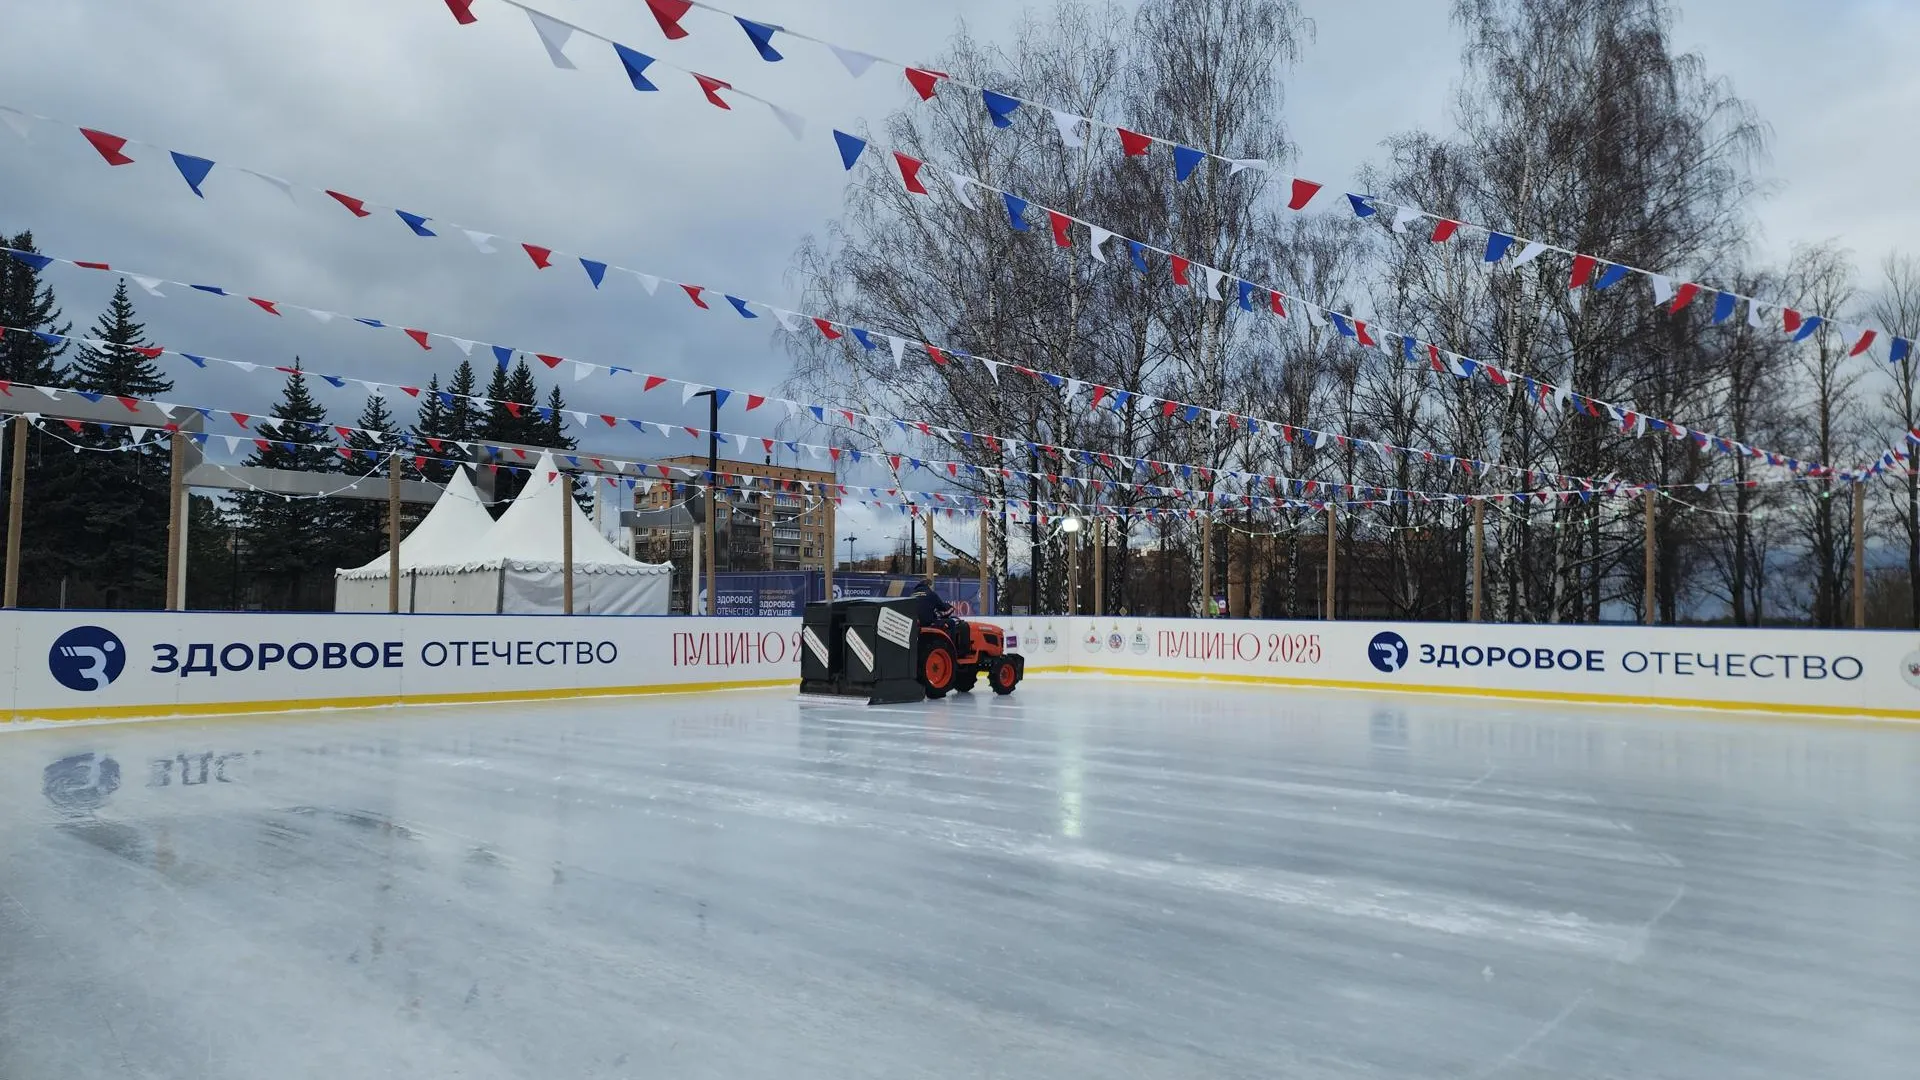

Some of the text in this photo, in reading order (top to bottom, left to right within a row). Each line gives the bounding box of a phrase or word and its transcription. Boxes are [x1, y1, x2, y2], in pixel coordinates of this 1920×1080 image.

[716, 595, 753, 604] ЗДОРОВОЕ
[716, 607, 755, 616] ОТЕЧЕСТВО
[759, 600, 795, 609] ЗДОРОВОЕ
[150, 640, 618, 678] ЗДОРОВОЕ ОТЕЧЕСТВО
[673, 631, 785, 668] ПУЩИНО
[1157, 631, 1261, 662] ПУЩИНО
[1267, 634, 1322, 664] 2025
[1419, 643, 1864, 681] ЗДОРОВОЕ ОТЕЧЕСТВО
